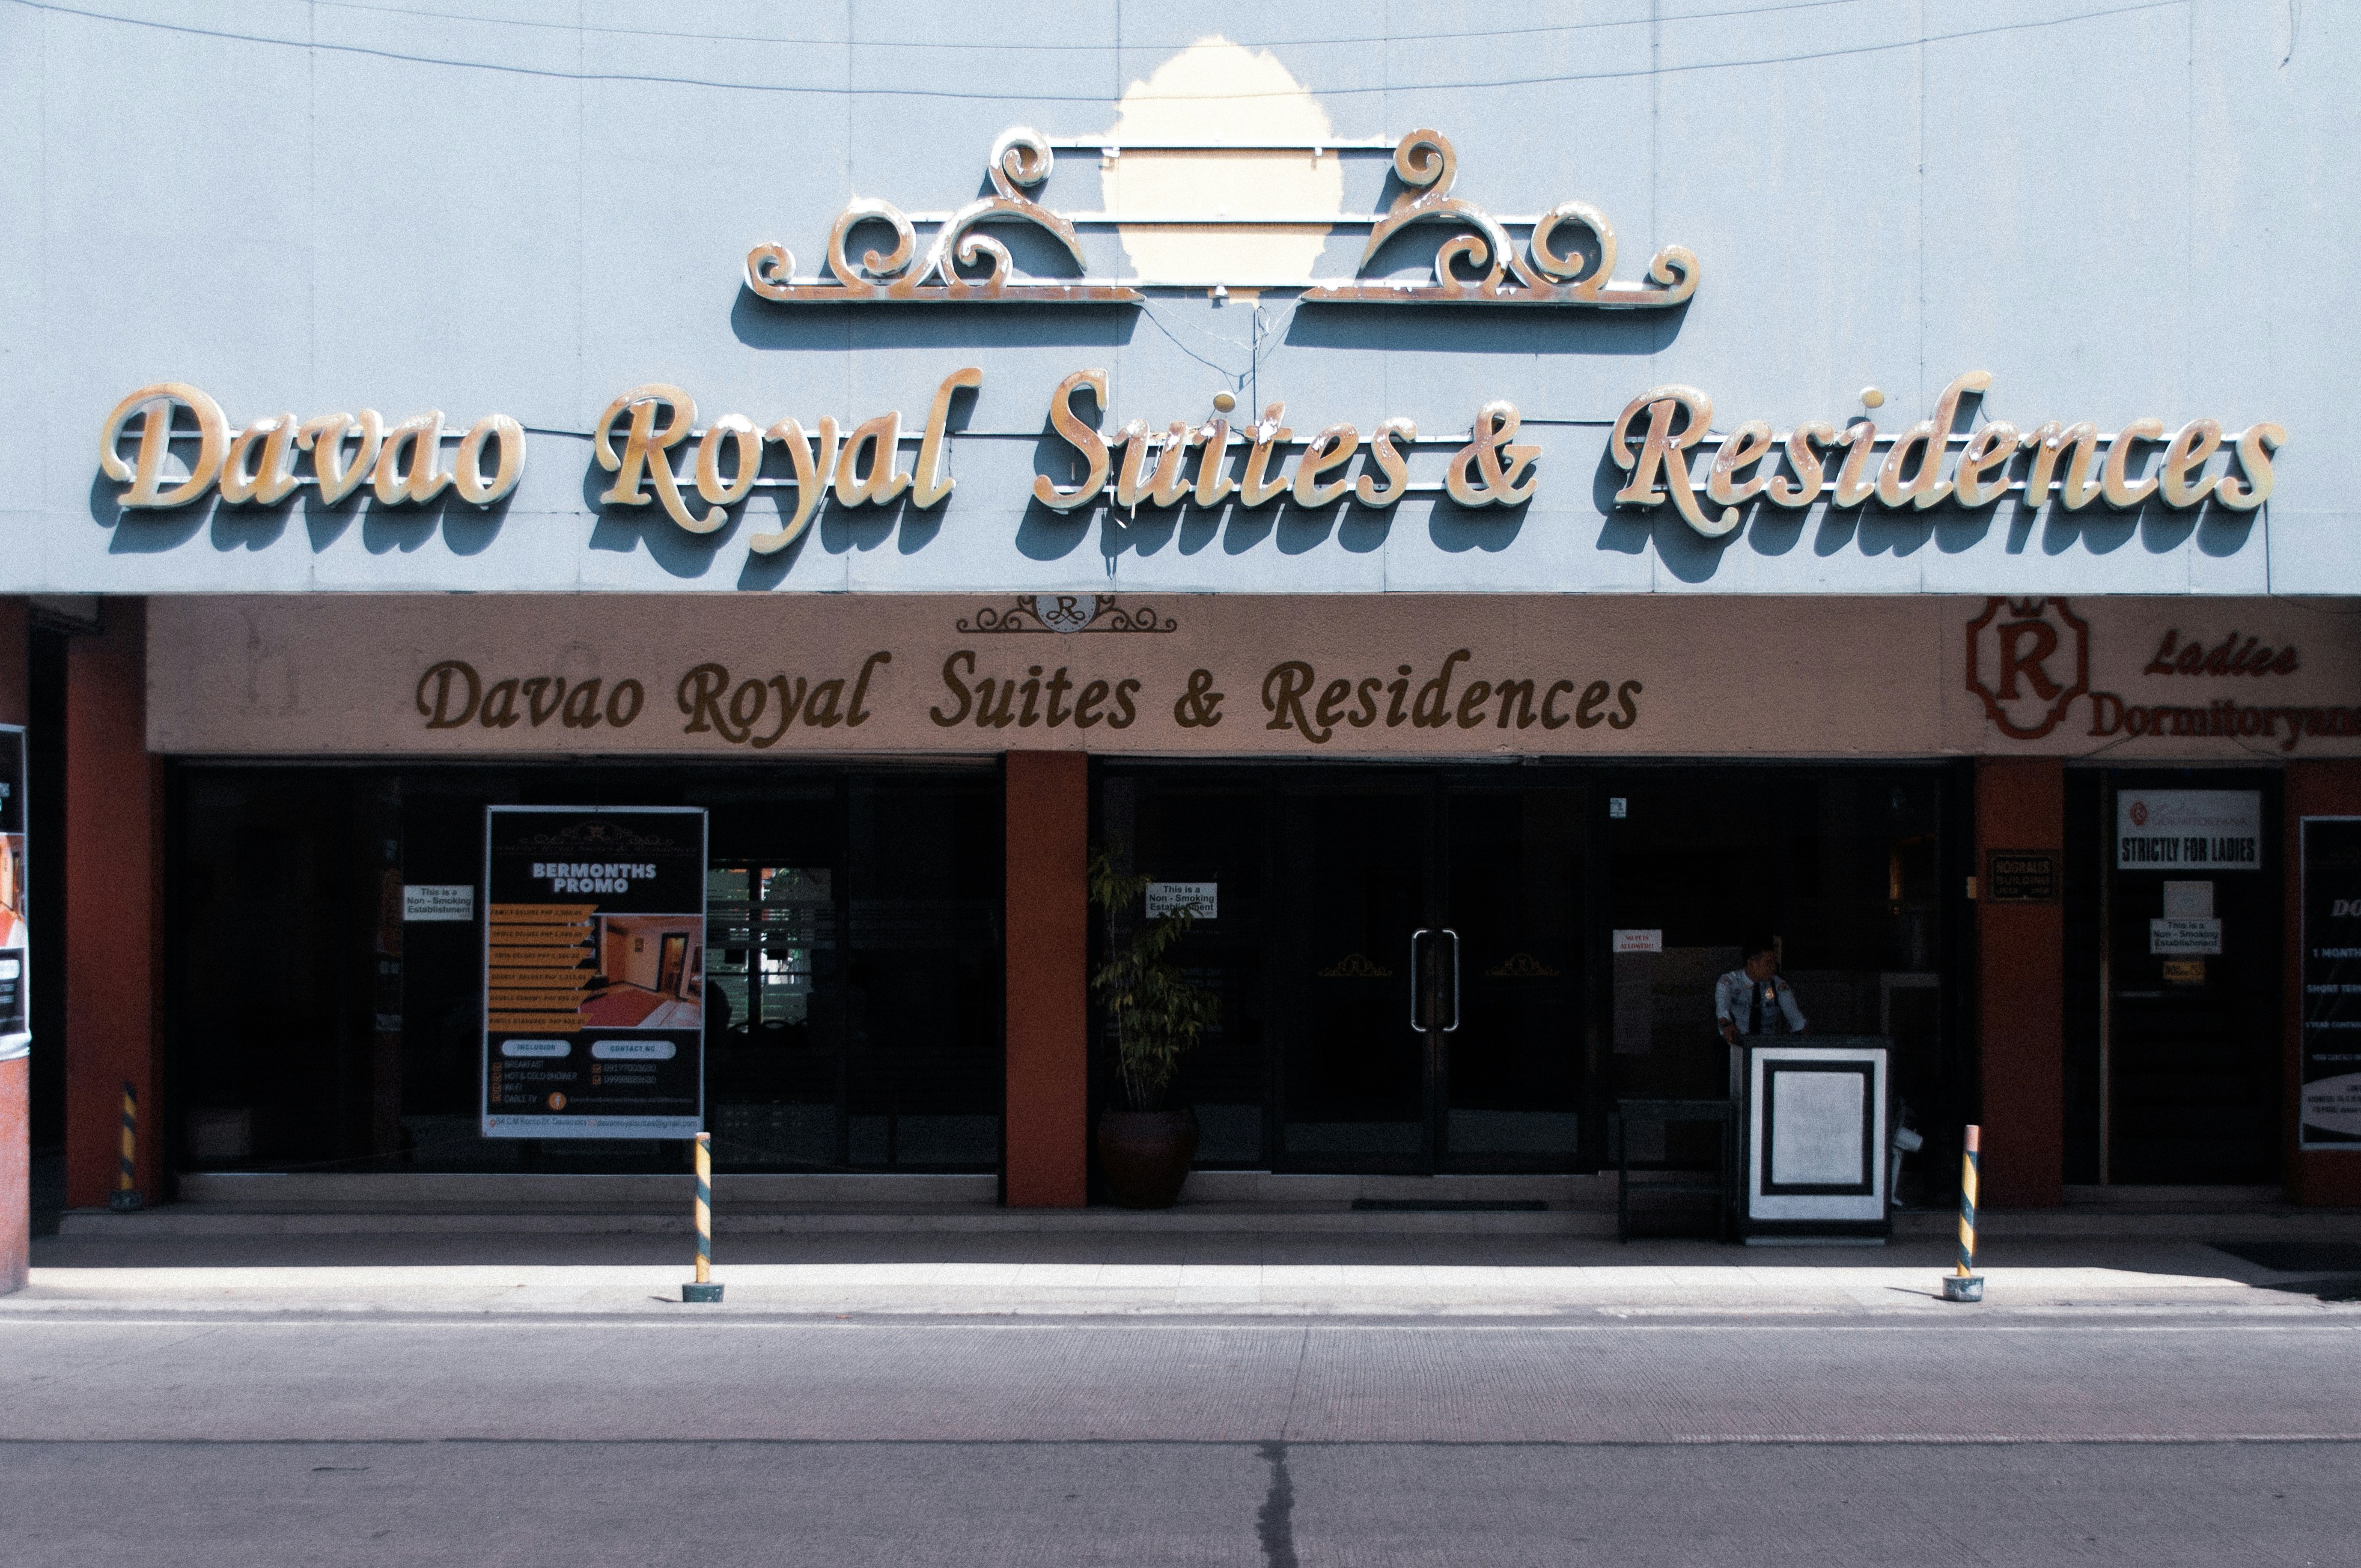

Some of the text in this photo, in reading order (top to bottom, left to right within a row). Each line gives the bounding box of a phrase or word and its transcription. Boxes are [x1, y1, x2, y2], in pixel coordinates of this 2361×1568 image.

[100, 366, 2287, 554] Davao Royal Suites & Residences
[2143, 628, 2300, 676] Ladies
[1996, 619, 2065, 701] R
[415, 648, 1643, 749] Davao Royal Suites & Residences
[2122, 837, 2255, 862] STRICTLY FOR LADIES
[532, 862, 657, 879] BERMONTHS
[553, 878, 629, 893] PROMO
[433, 897, 471, 905] Smoking
[1175, 895, 1214, 904] Smoking
[2180, 931, 2218, 940] Smoking
[2306, 983, 2338, 994] SHORT
[505, 1060, 544, 1069] BREAKFAST
[546, 1072, 577, 1080] SHOWER
[504, 1094, 537, 1103] CABLE TV
